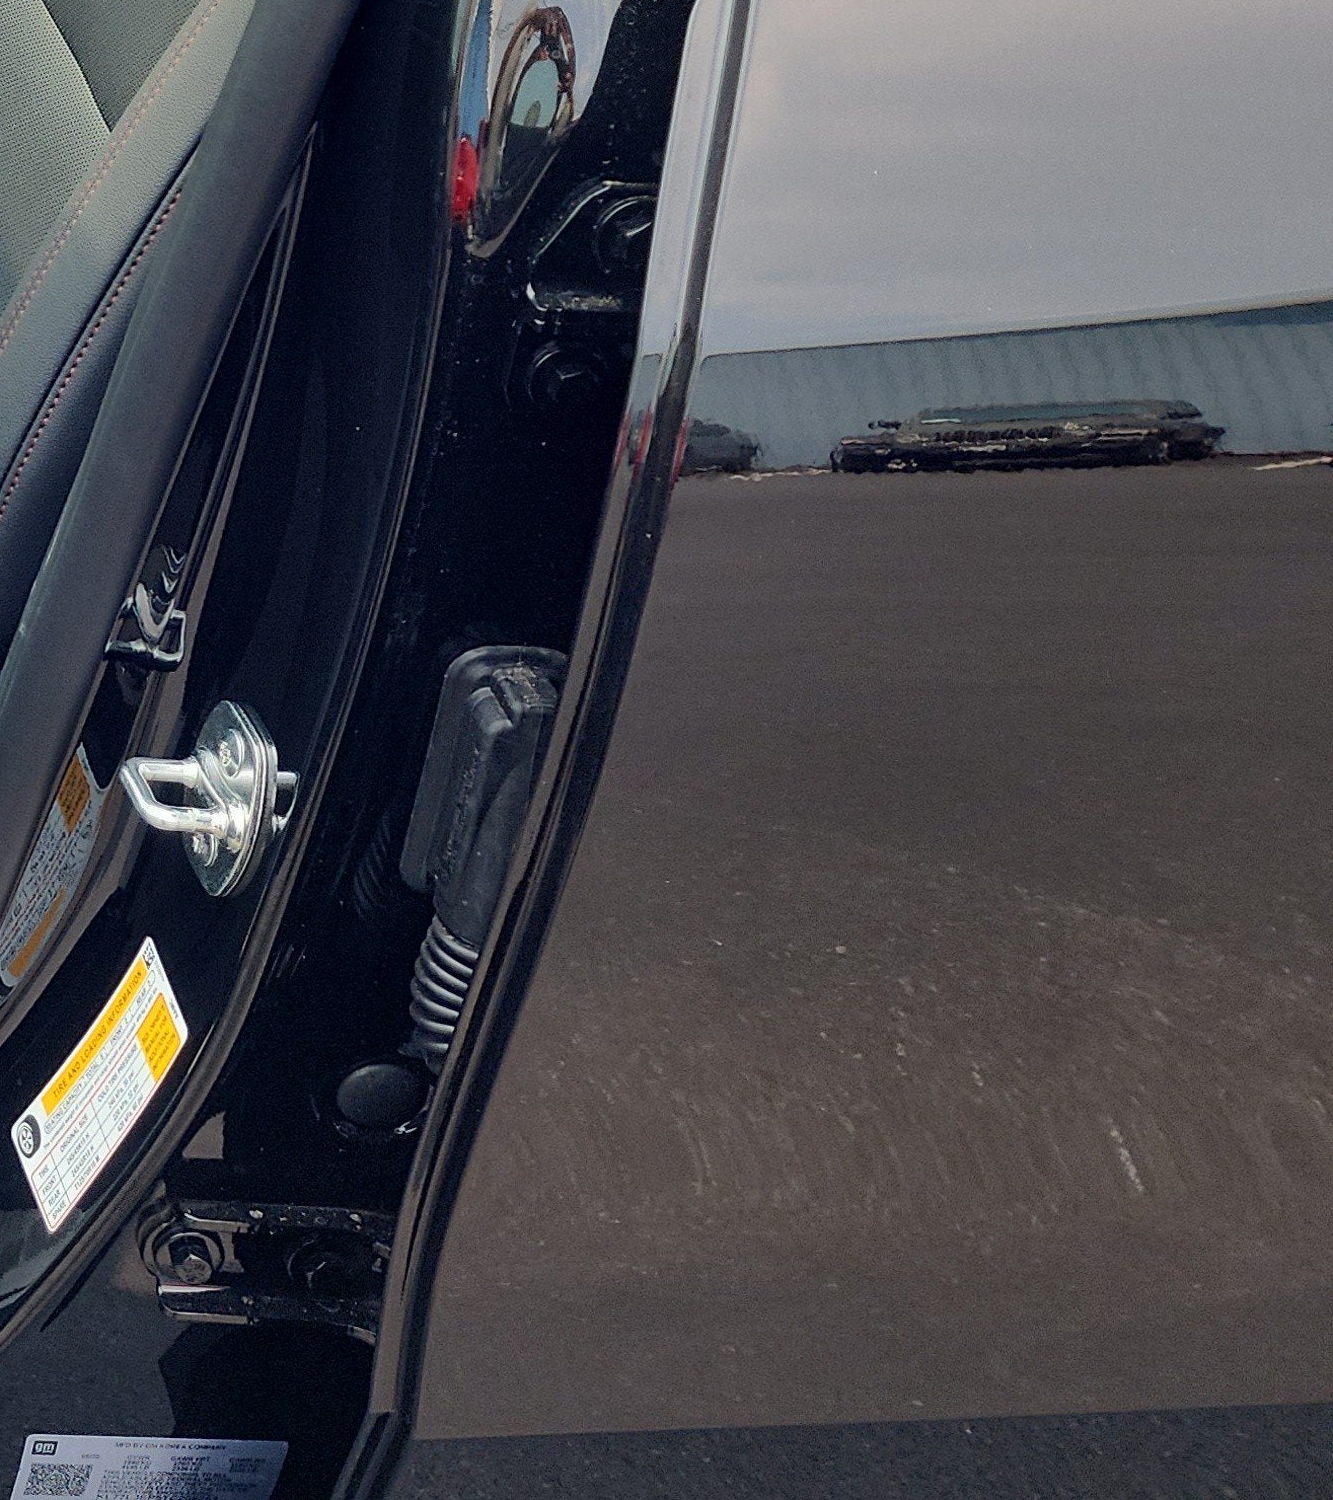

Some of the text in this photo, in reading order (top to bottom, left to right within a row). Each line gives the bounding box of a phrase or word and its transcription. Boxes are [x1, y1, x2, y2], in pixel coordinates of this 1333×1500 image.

[52, 1076, 68, 1100] TIRE
[66, 1057, 81, 1082] AND
[79, 1021, 107, 1064] LOADING
[105, 968, 142, 1028] INFORMATION
